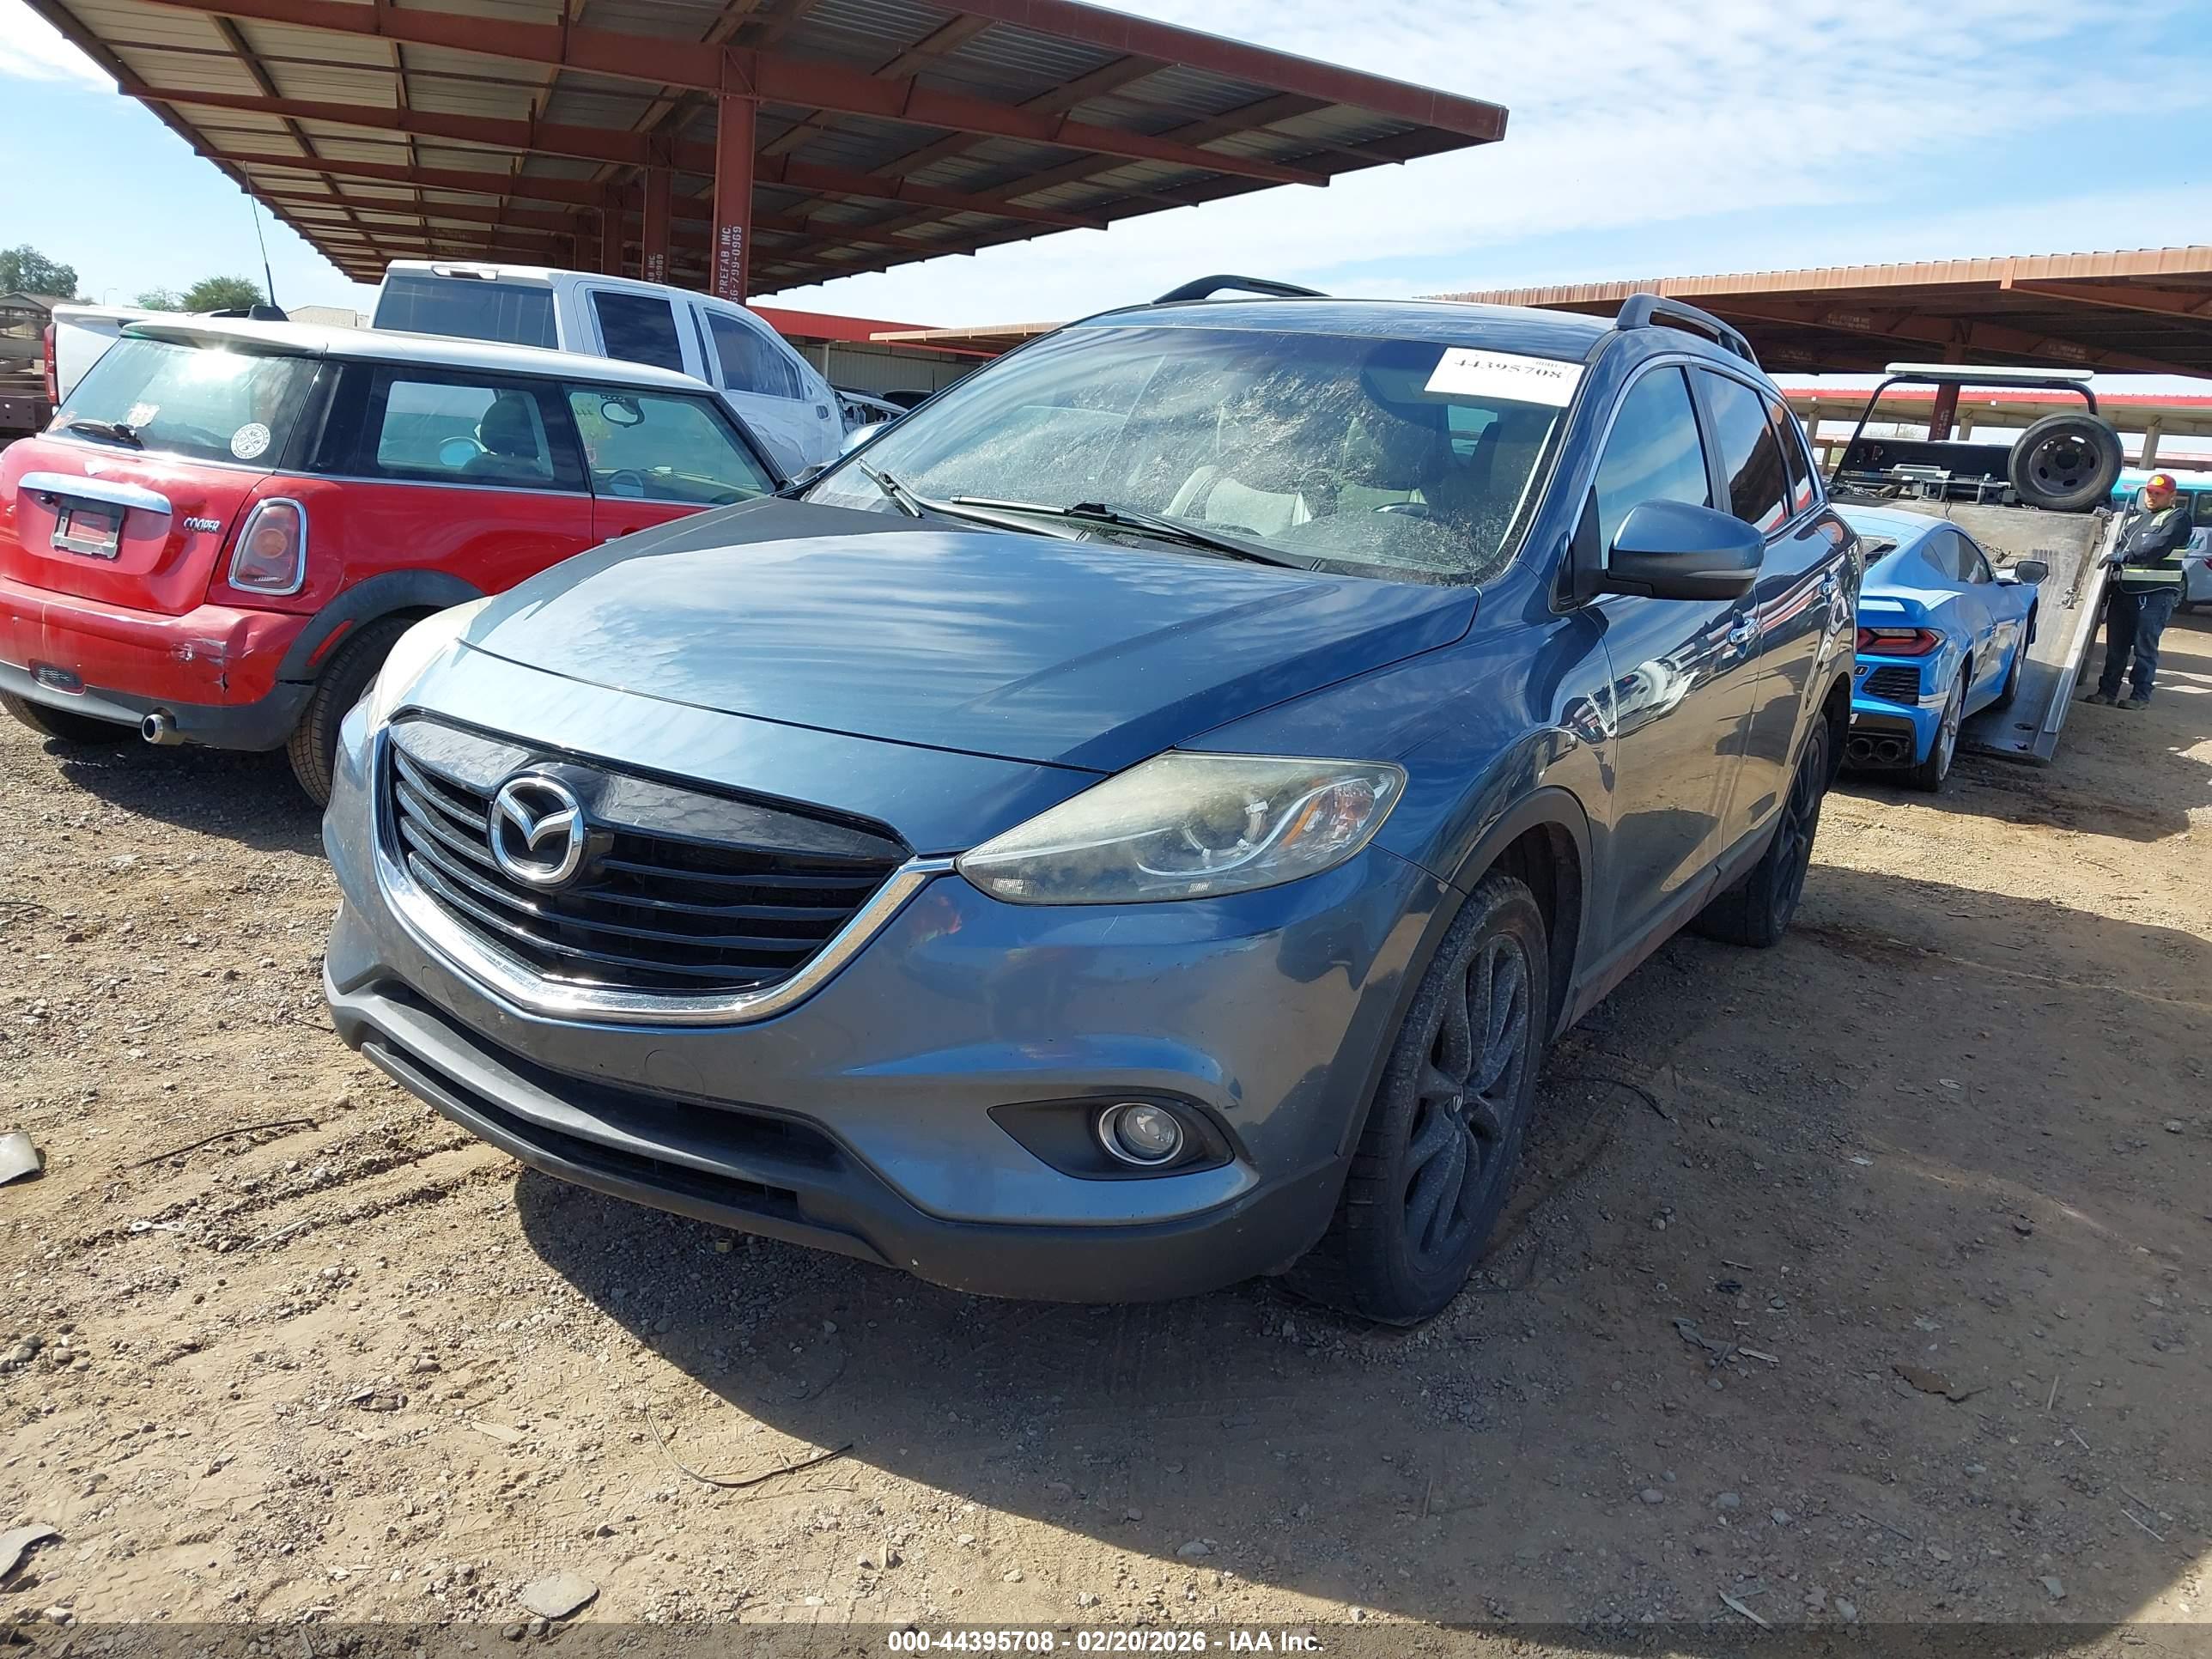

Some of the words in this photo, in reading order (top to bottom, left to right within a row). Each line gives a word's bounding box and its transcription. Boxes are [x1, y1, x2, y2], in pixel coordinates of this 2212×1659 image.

[720, 224, 732, 246] INC.
[719, 250, 730, 294] PREFAB
[1454, 358, 1563, 380] 44395708
[183, 516, 221, 532] COOPER
